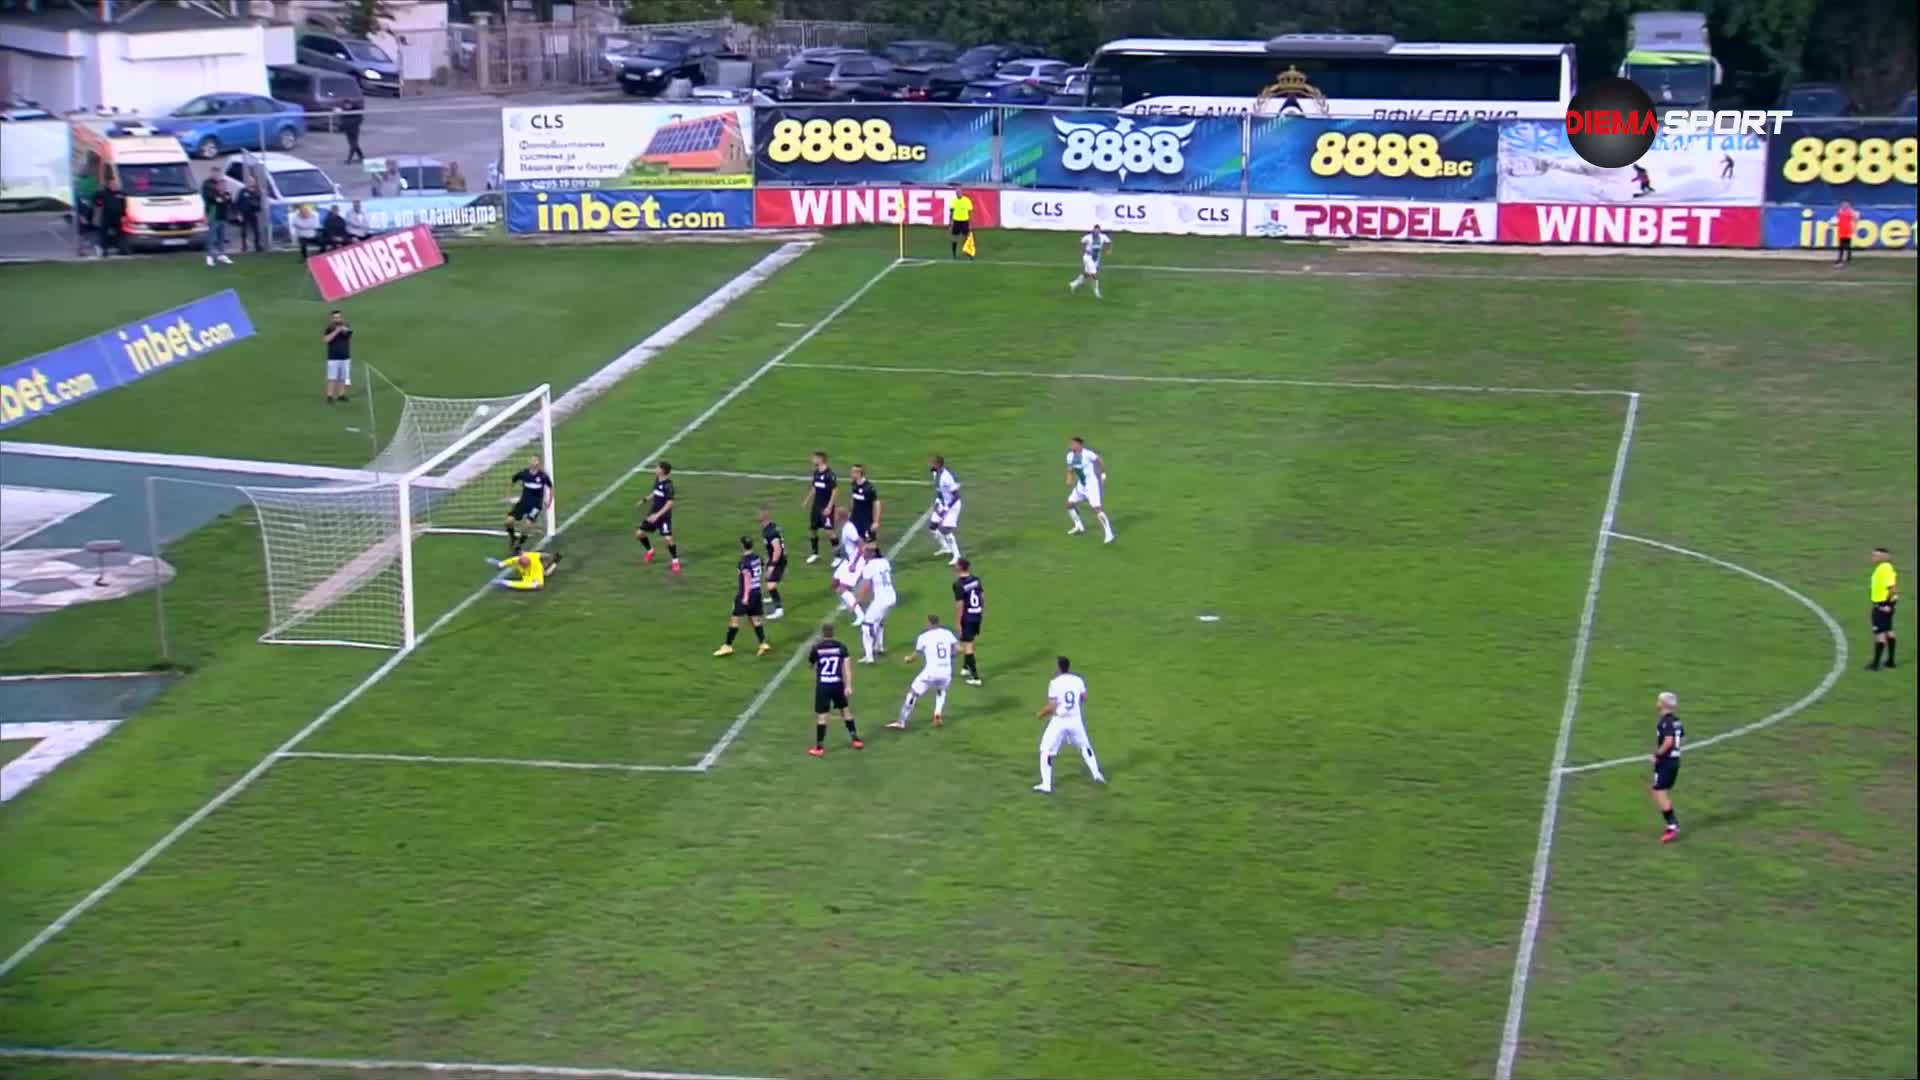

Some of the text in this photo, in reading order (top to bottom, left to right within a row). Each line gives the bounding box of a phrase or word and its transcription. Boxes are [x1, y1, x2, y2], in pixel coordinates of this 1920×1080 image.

[530, 114, 565, 129] CLS
[768, 118, 927, 163] 8888.BG
[1061, 129, 1185, 175] 8888
[1310, 132, 1473, 178] 8888.BG
[537, 193, 725, 231] inbet.com
[790, 189, 959, 225] WINBET
[1031, 202, 1064, 216] CLS
[1114, 205, 1147, 219] CLS
[1197, 208, 1230, 222] CLS
[1294, 204, 1483, 237] PREDELA
[1535, 205, 1721, 245] WINBET
[326, 231, 422, 292] WINBET
[118, 316, 235, 373] inbet.com
[970, 590, 980, 607] 6
[820, 657, 839, 675] 27
[936, 642, 947, 659] 6
[1065, 691, 1075, 711] 9
